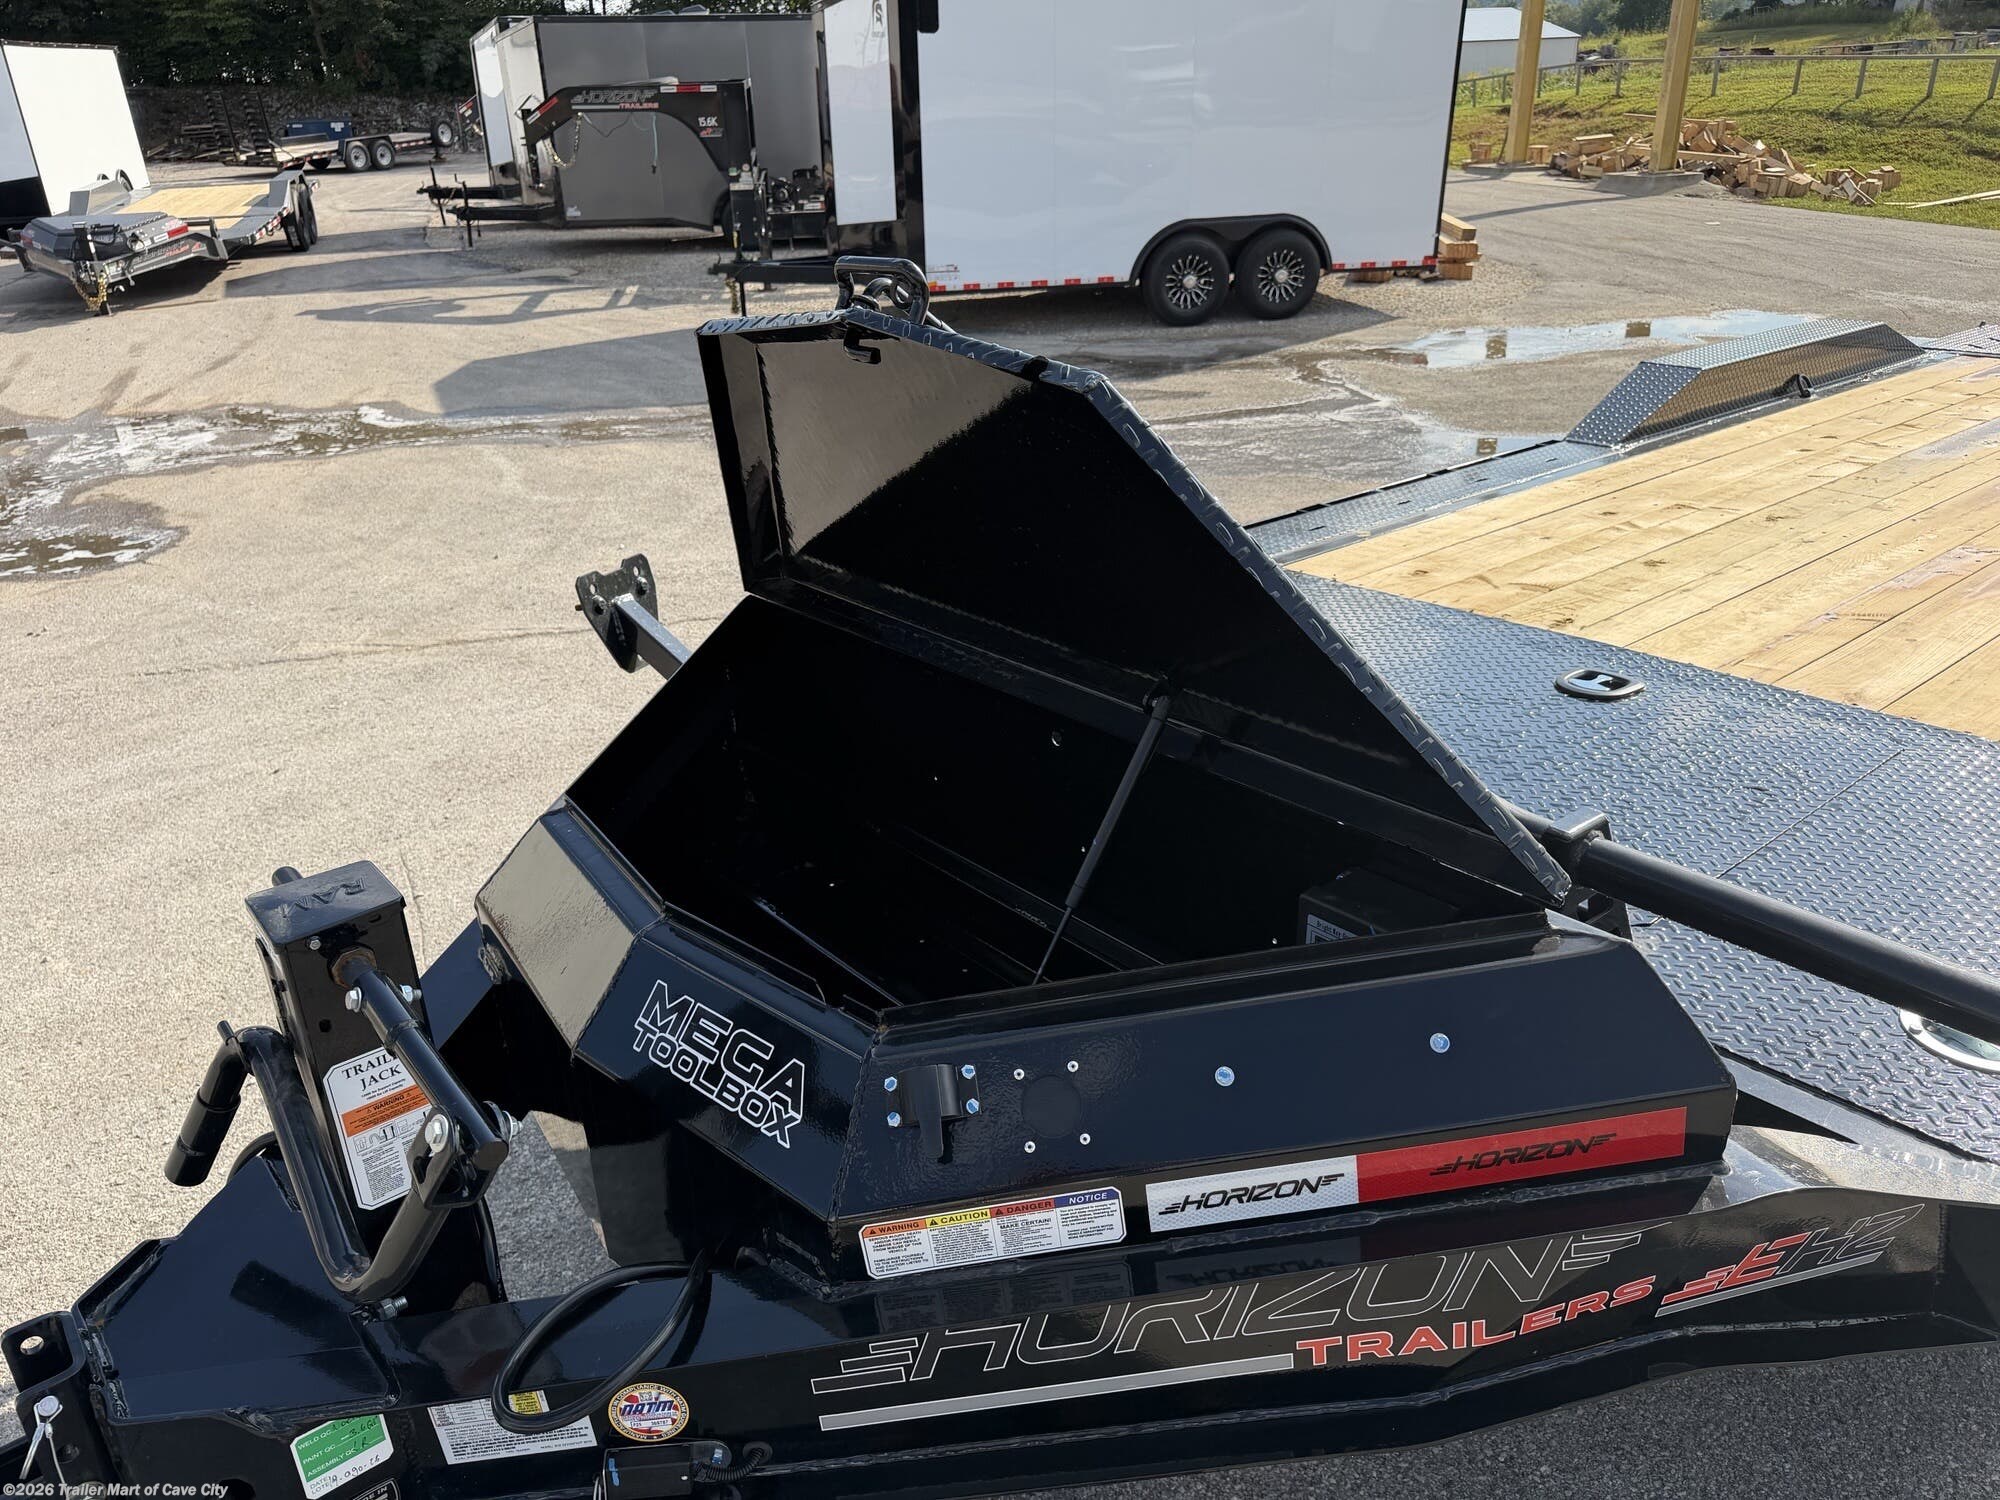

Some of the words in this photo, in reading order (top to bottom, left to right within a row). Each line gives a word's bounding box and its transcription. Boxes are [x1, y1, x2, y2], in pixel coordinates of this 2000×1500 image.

[638, 979, 805, 1120] MEGA
[342, 1053, 399, 1079] TRAIL
[360, 1064, 402, 1091] JACK
[633, 1018, 802, 1149] TOOLBOX
[373, 1095, 405, 1111] WARNING
[1455, 1136, 1600, 1177] HORIZON
[1069, 1192, 1108, 1205] NOTICE
[1176, 1176, 1330, 1214] HORIZON
[940, 1210, 988, 1225] CAUTION
[1007, 1201, 1052, 1214] DANGER
[878, 1221, 919, 1233] WARNING
[1000, 1222, 1019, 1230] MAKE
[1296, 1275, 1656, 1367] TRAILERS
[298, 1437, 319, 1450] WELD
[302, 1450, 323, 1465] PAINT
[307, 1453, 345, 1477] ASSEMBLY
